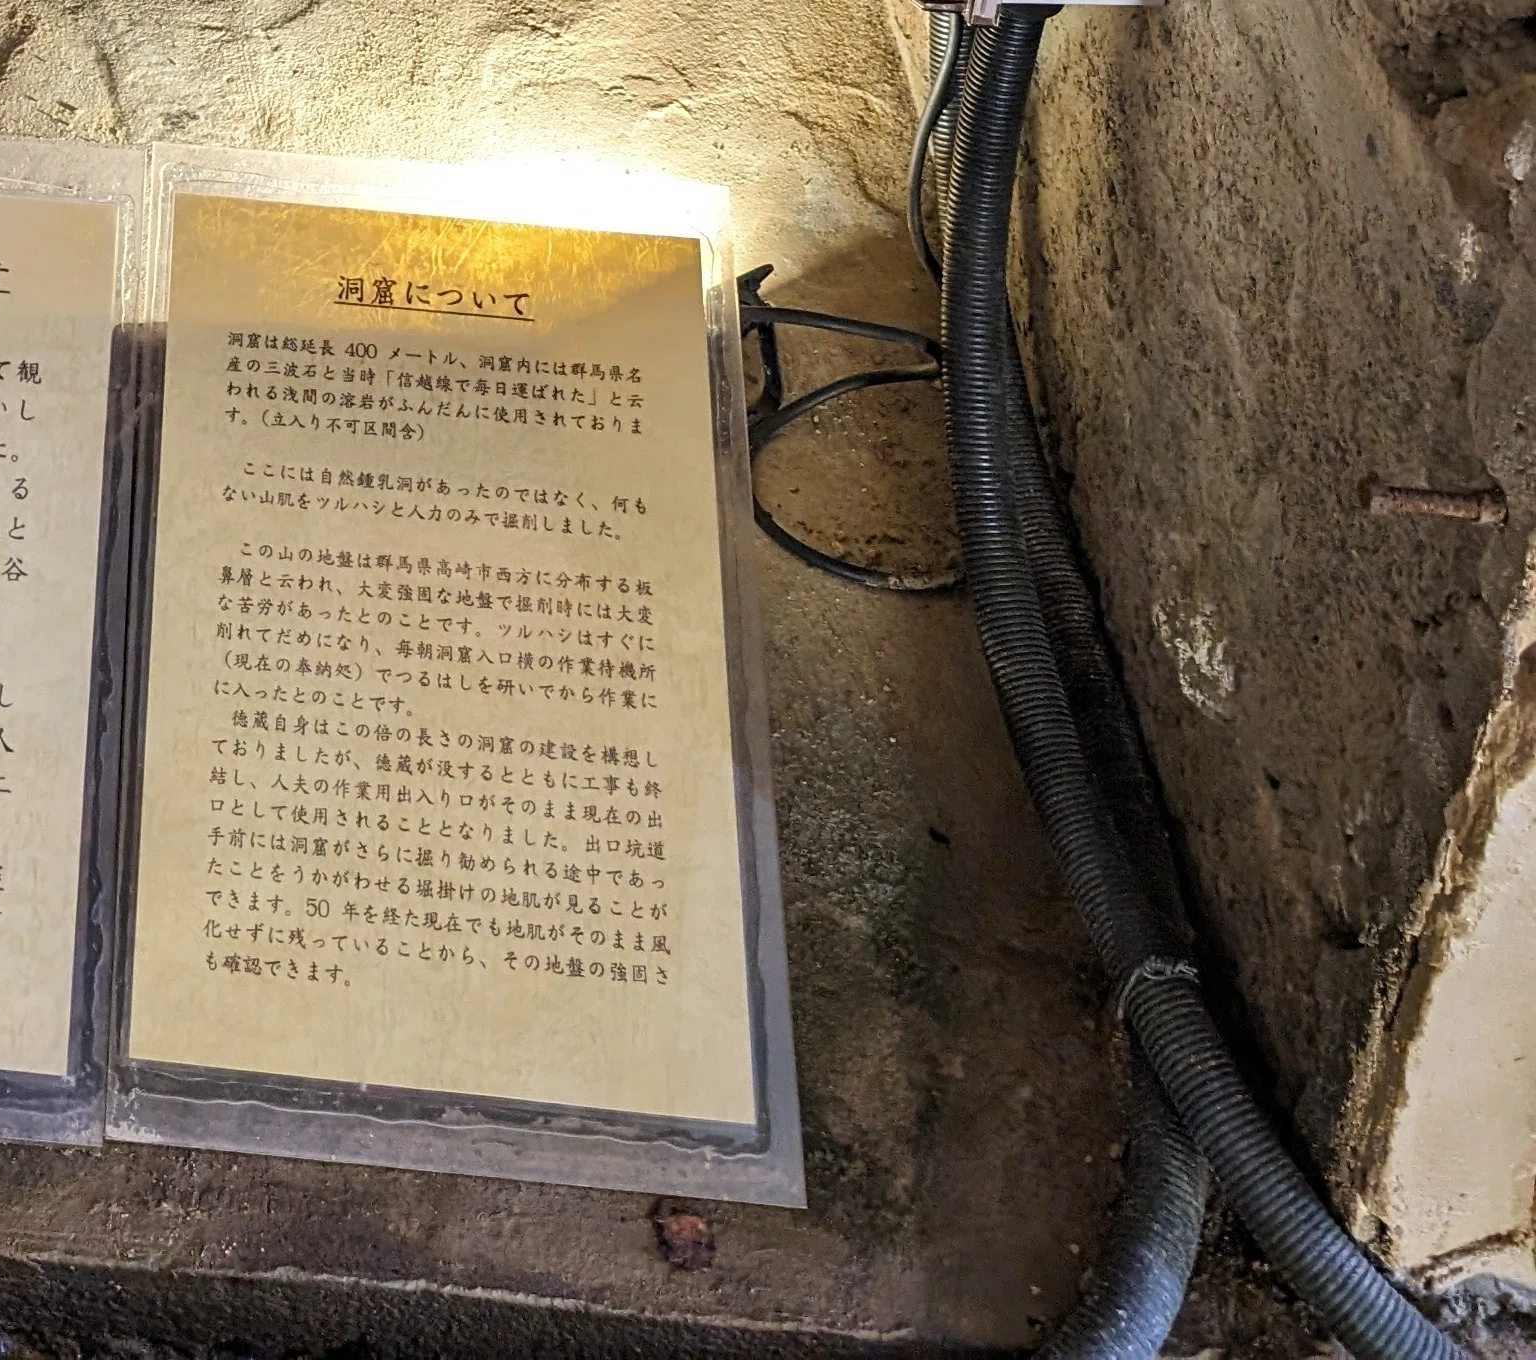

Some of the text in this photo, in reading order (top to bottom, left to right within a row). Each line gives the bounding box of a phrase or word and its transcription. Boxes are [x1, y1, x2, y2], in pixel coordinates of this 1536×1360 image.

[338, 276, 530, 315] 洞窟について
